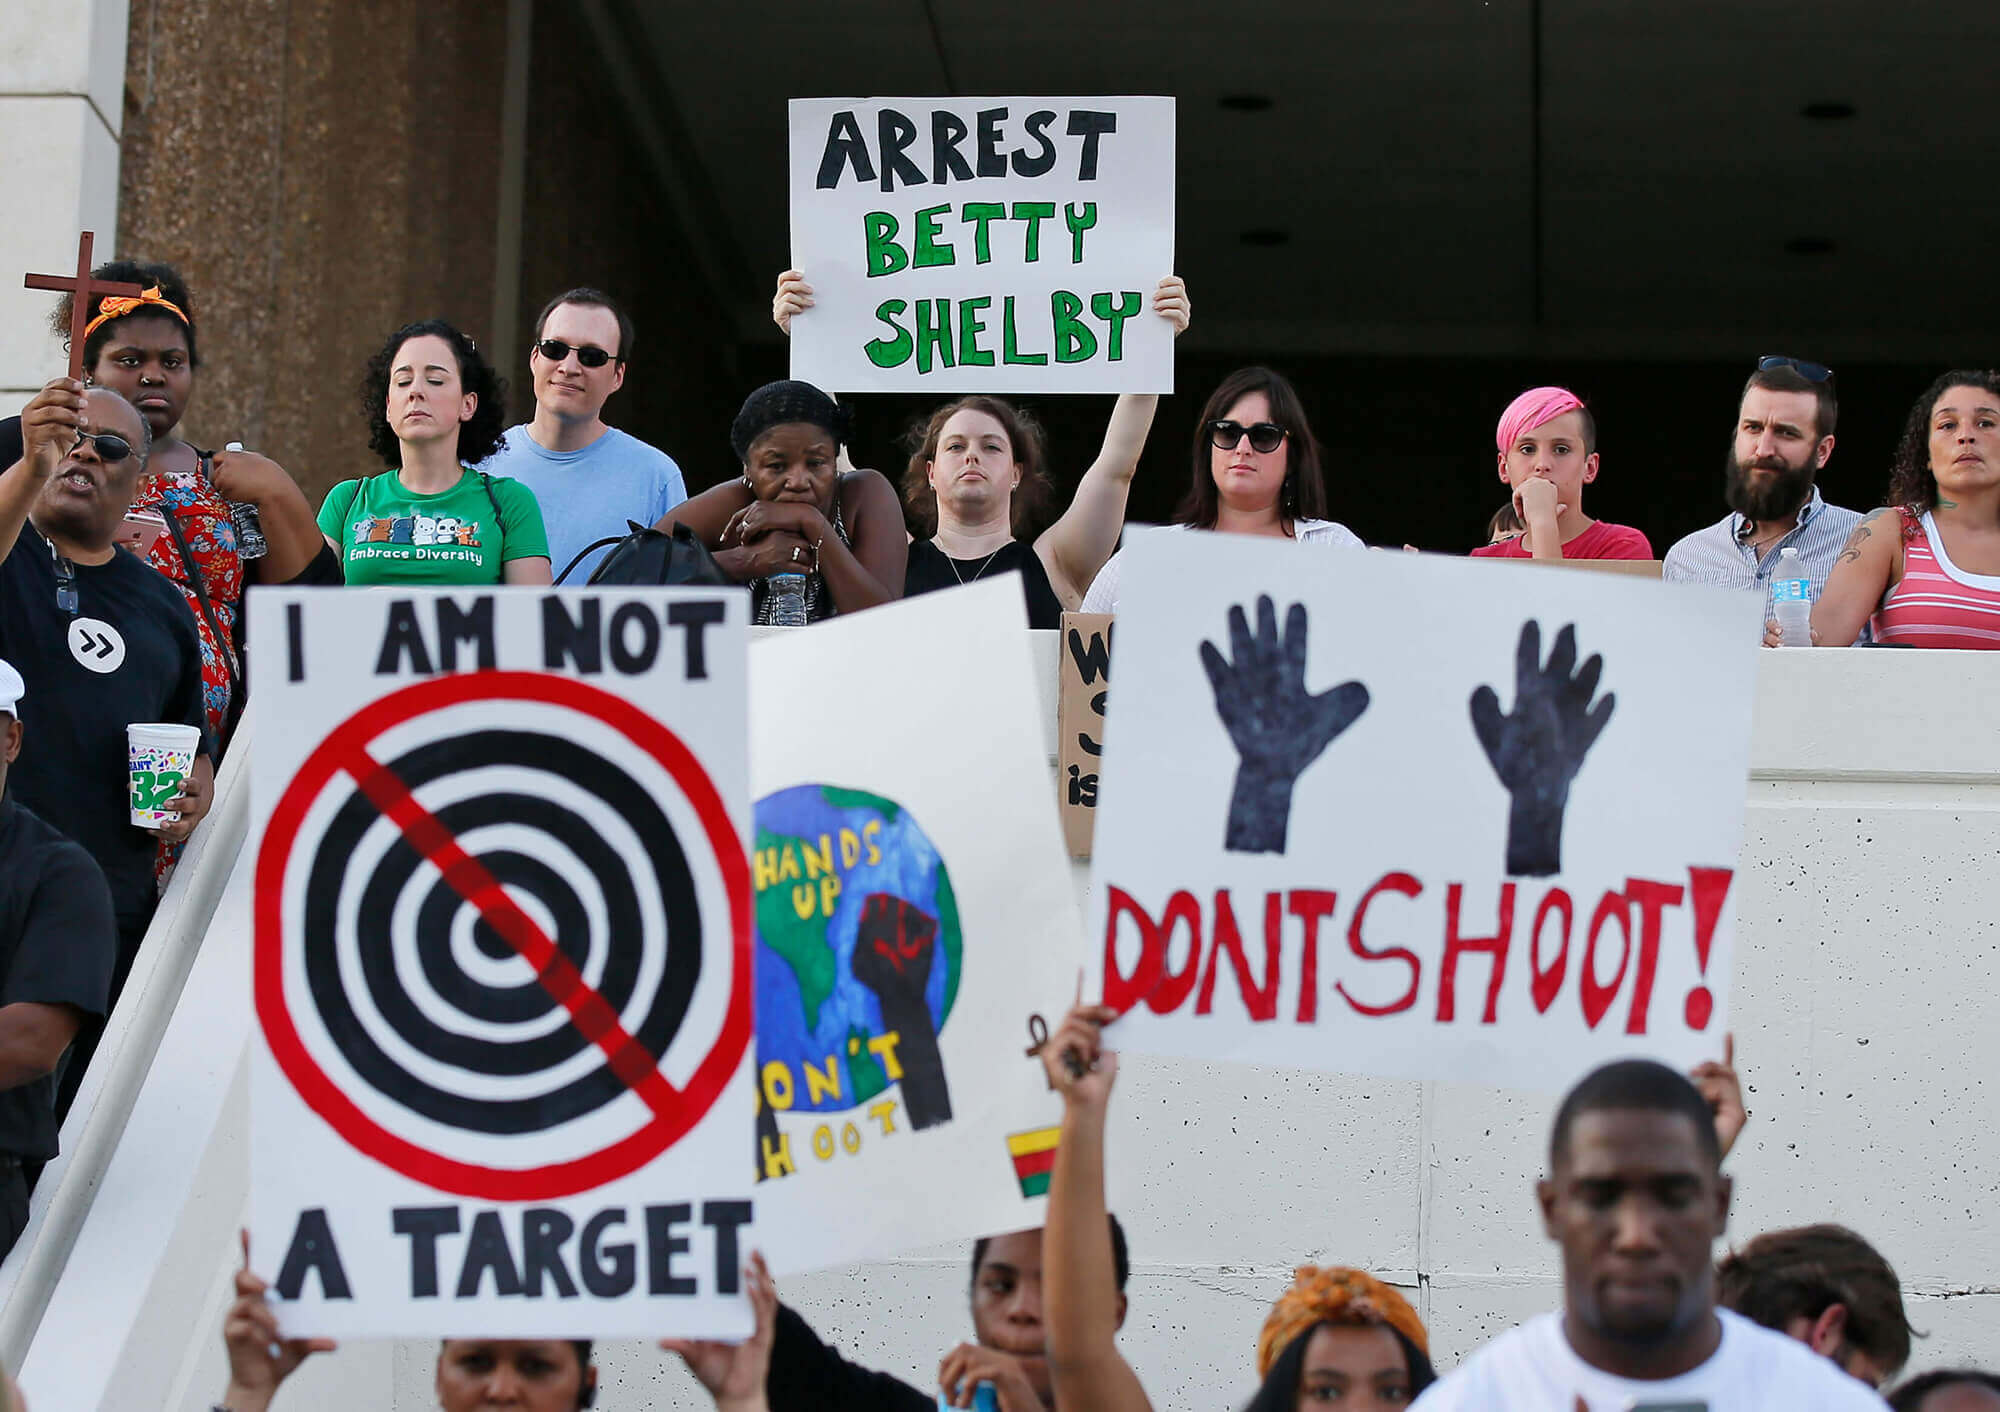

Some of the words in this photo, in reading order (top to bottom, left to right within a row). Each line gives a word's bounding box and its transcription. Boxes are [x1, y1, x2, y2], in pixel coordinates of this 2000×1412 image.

[816, 107, 1116, 192] ARREST
[864, 202, 1097, 277] BETTY
[864, 291, 1142, 374] SHELBY
[349, 547, 410, 562] Embrace
[415, 548, 483, 567] Diversity
[285, 603, 304, 682] I
[374, 595, 496, 674] AM
[541, 597, 726, 680] NOT
[131, 771, 184, 812] 32
[754, 819, 882, 891] HANDS
[792, 874, 842, 920] UP
[755, 1030, 904, 1118] ON'T
[755, 1100, 899, 1182] HOOT
[274, 1208, 353, 1300] A
[392, 1200, 753, 1299] TARGET
